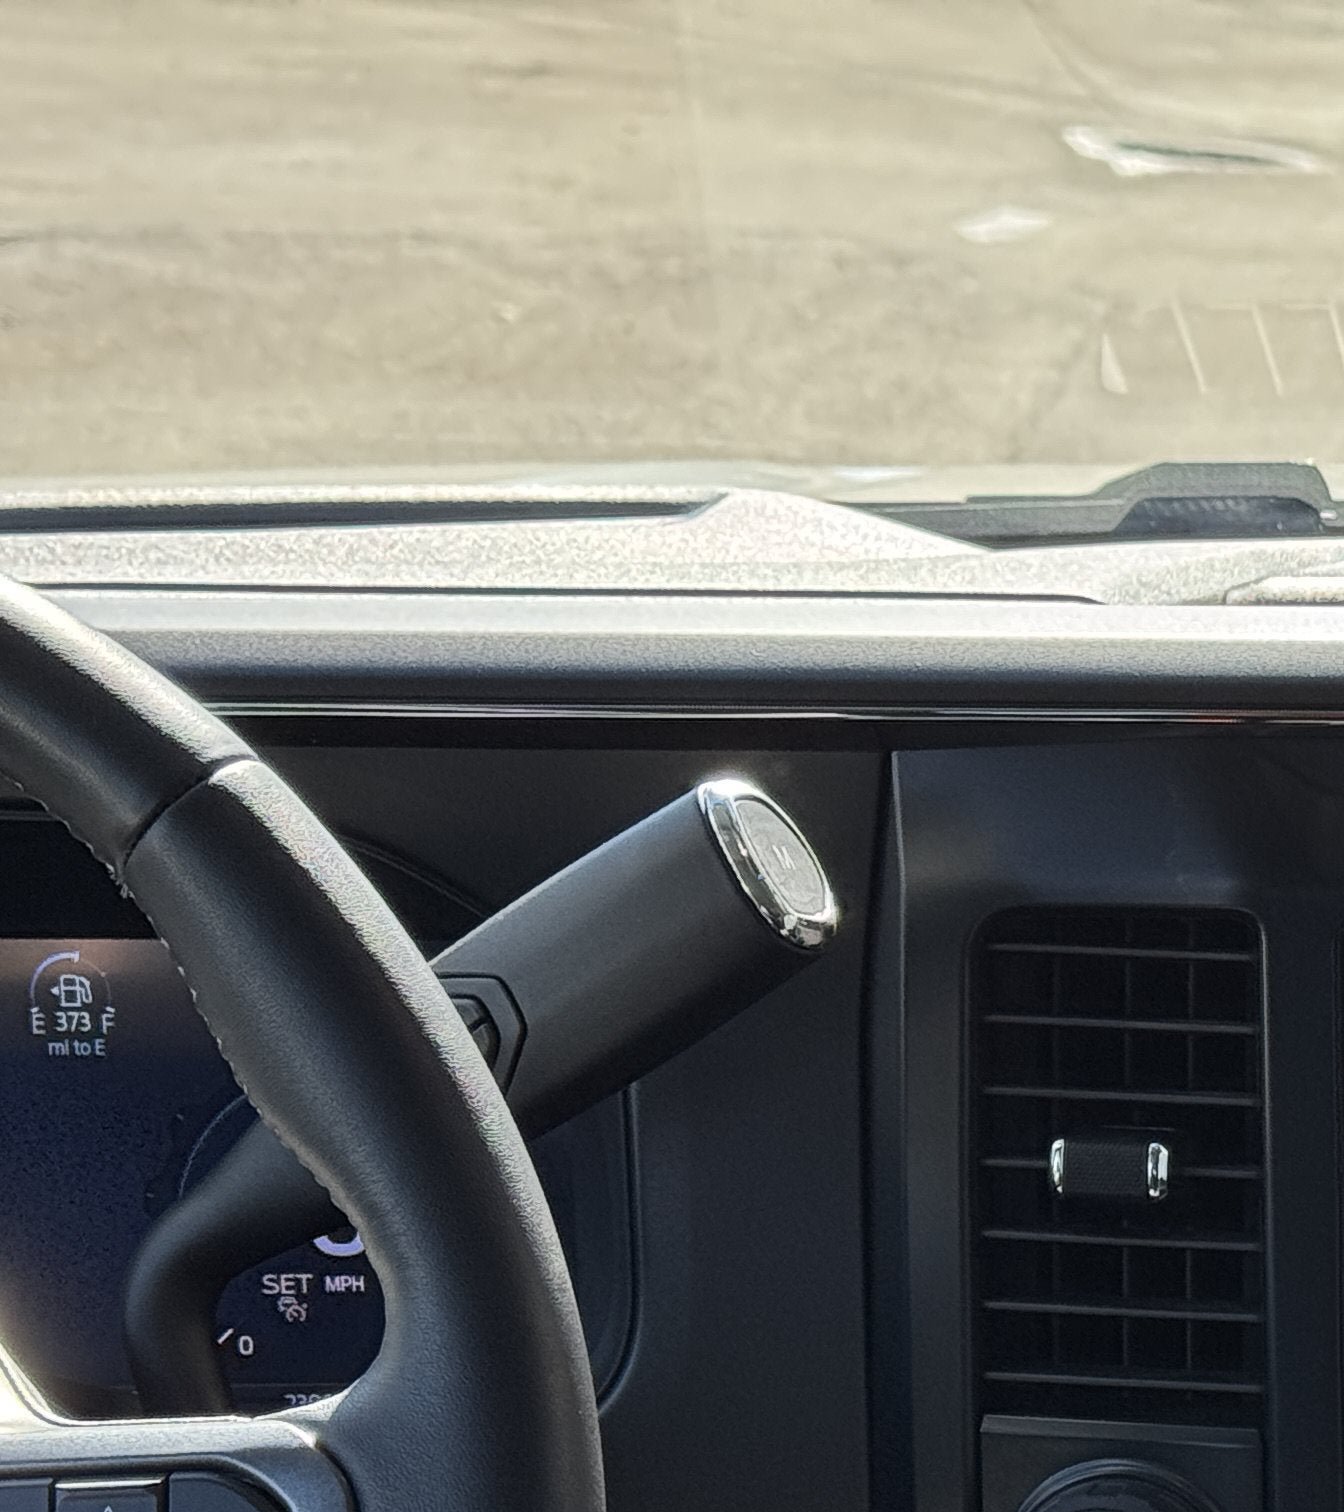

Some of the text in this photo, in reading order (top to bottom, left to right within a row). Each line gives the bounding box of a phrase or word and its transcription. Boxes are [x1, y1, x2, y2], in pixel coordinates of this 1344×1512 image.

[32, 1011, 116, 1035] E 373 F
[73, 1040, 92, 1056] to
[95, 1038, 106, 1056] E
[262, 1275, 365, 1295] SET MPH
